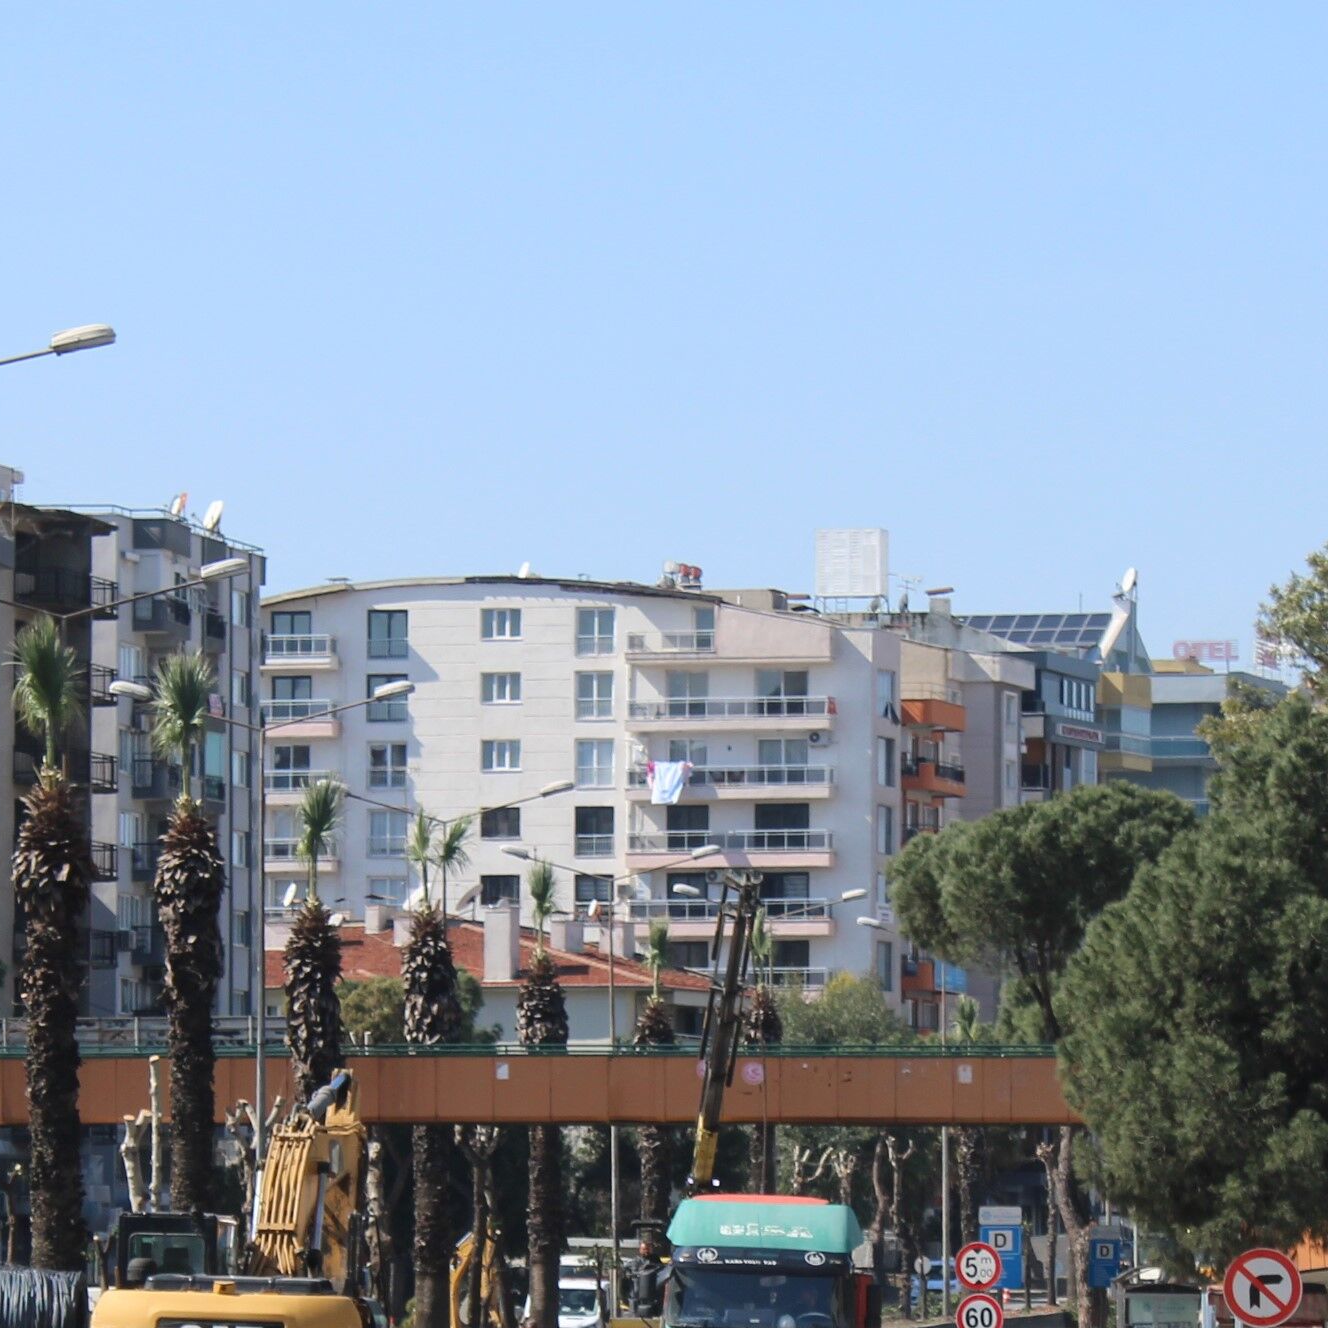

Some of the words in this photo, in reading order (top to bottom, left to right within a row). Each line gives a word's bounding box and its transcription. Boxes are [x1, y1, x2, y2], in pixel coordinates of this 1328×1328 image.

[1173, 640, 1239, 661] OTEL
[994, 1233, 1007, 1248] D
[1100, 1245, 1110, 1257] D
[965, 1257, 978, 1278] 5
[965, 1307, 993, 1328] 60
